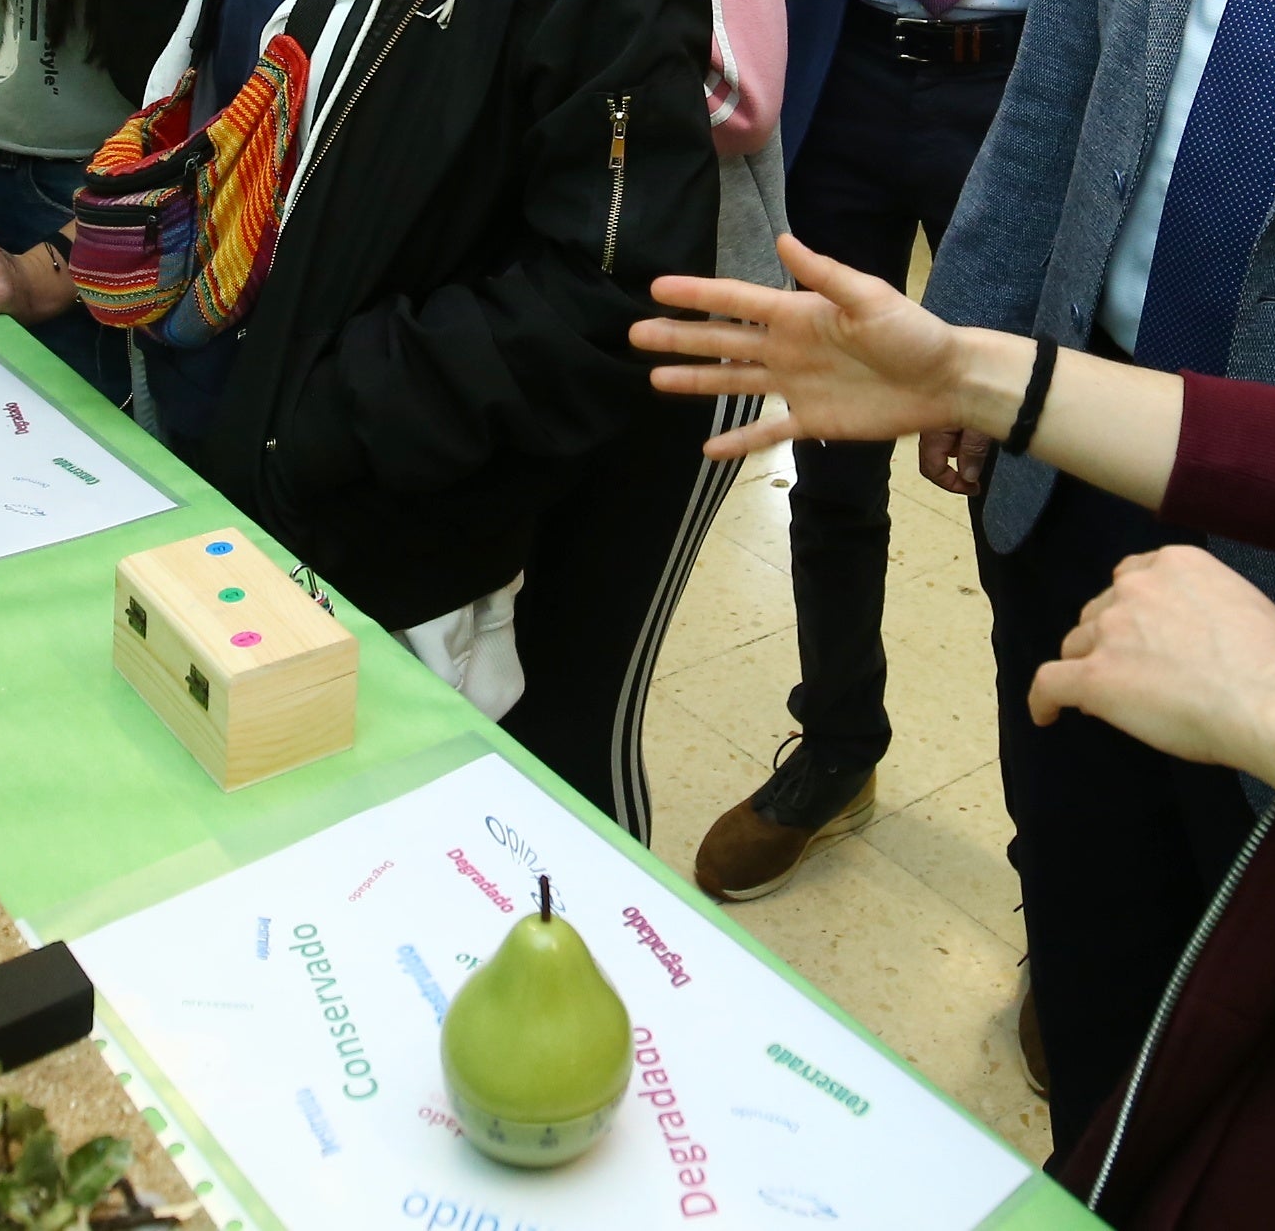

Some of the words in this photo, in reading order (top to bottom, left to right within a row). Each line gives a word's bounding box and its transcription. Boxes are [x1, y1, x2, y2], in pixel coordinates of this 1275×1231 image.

[52, 457, 100, 486] Conservado
[348, 859, 395, 903] Degradado
[446, 848, 514, 914] Degradado
[622, 906, 691, 989] Degradado
[288, 923, 379, 1101] Conservado
[767, 1043, 870, 1117] Conservado
